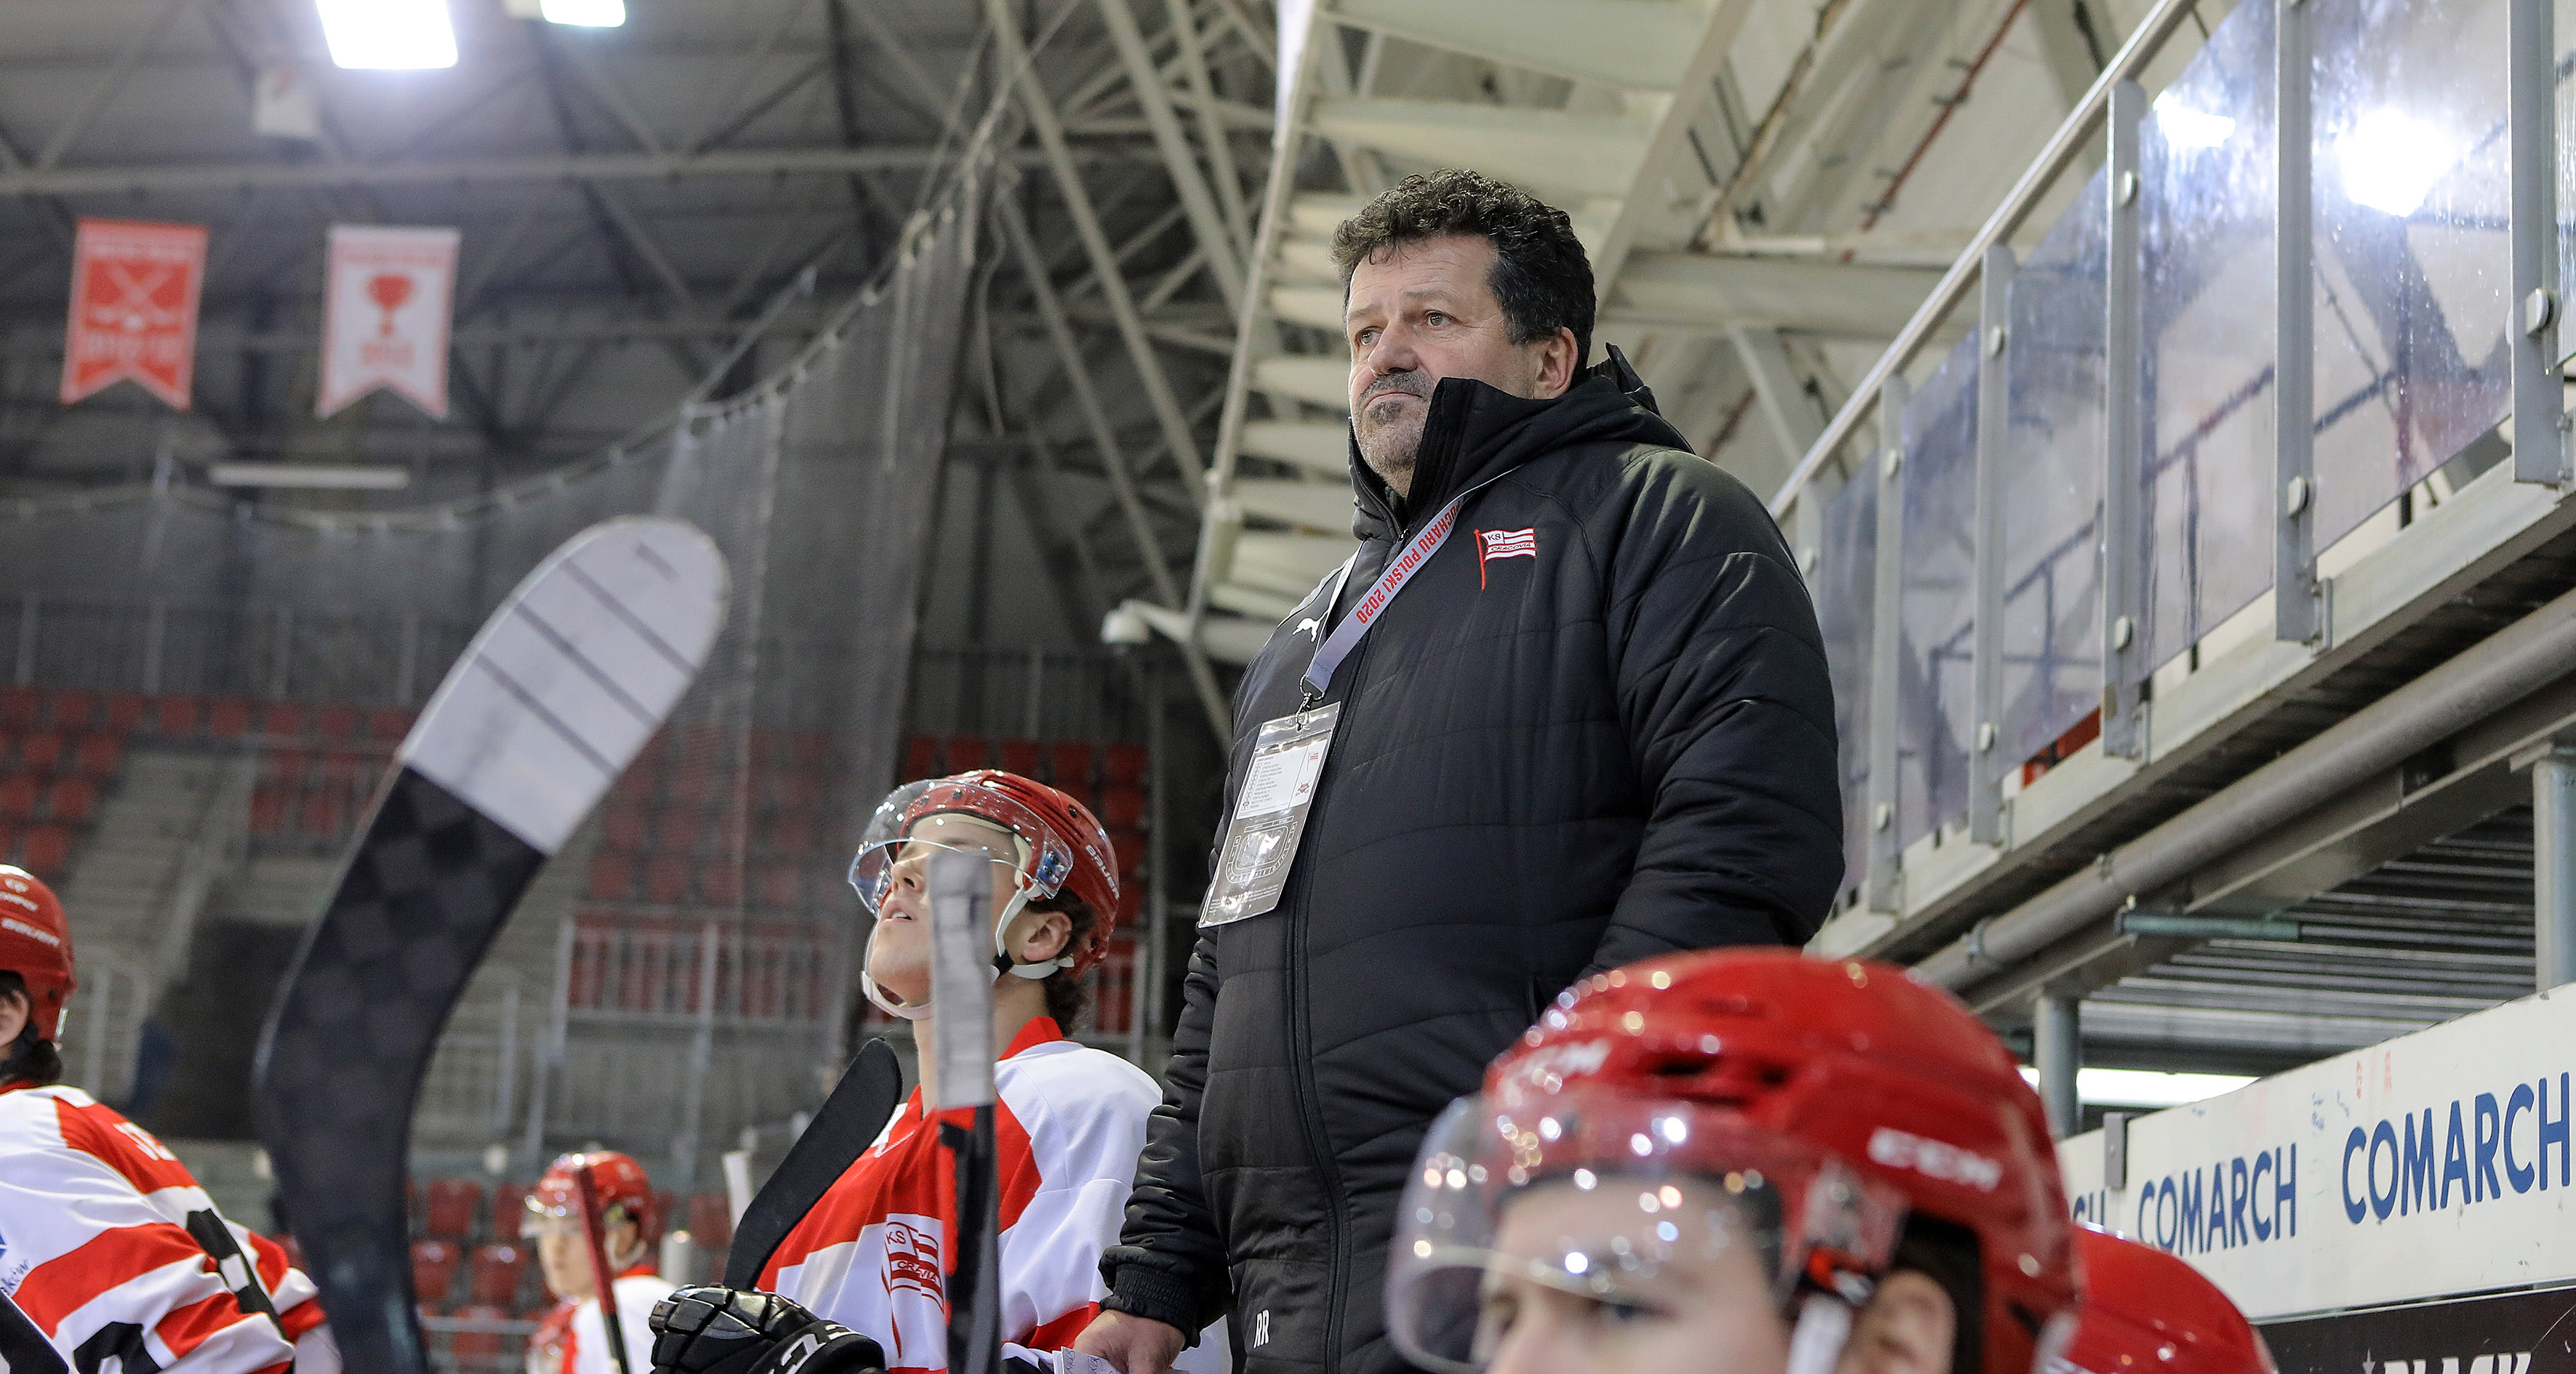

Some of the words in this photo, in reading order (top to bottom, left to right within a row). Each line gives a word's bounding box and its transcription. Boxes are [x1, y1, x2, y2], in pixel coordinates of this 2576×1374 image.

[1490, 542, 1531, 551] CRACOVIA
[1382, 547, 1422, 592] POLSKI
[1355, 588, 1386, 624] 2020
[2342, 1071, 2571, 1224] COMARCH
[2138, 1142, 2296, 1256] COMARCH
[886, 1230, 907, 1245] KS
[1253, 1309, 1269, 1349] RR
